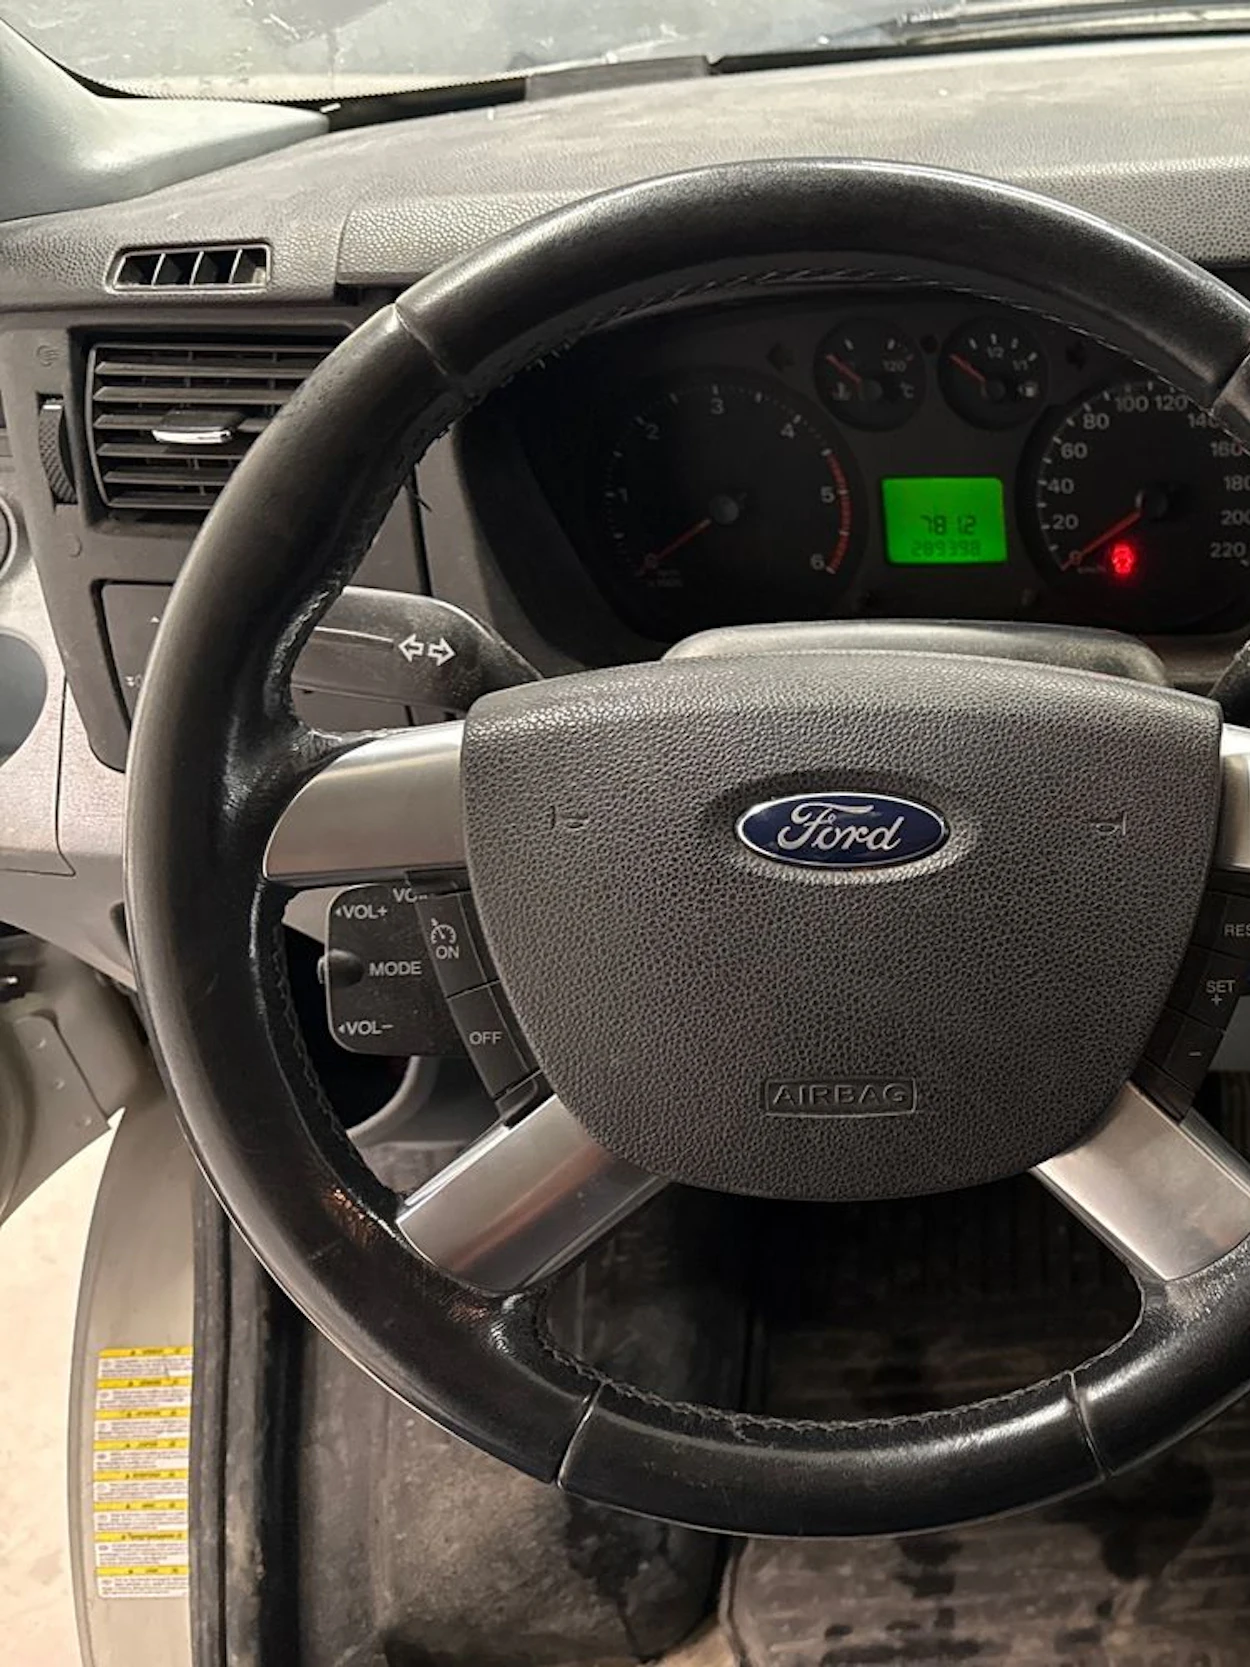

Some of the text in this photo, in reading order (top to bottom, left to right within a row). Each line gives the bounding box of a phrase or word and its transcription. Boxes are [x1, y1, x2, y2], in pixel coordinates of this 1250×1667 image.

[711, 398, 725, 415] 3
[1116, 396, 1149, 411] 100
[1155, 395, 1188, 411] 120
[1083, 413, 1110, 430] 80
[647, 424, 661, 440] 2
[780, 423, 795, 439] 4
[1061, 442, 1088, 459] 60
[1210, 441, 1243, 457] 160
[1047, 477, 1075, 494] 40
[820, 486, 834, 503] 5
[1053, 514, 1079, 530] 20
[1210, 541, 1246, 558] 220
[810, 553, 825, 571] 6
[777, 801, 905, 851] Ford
[435, 945, 460, 960] ON
[369, 960, 422, 977] MODE
[1205, 979, 1236, 994] SET
[468, 1031, 503, 1046] OFF
[772, 1083, 907, 1106] AIRBAG
